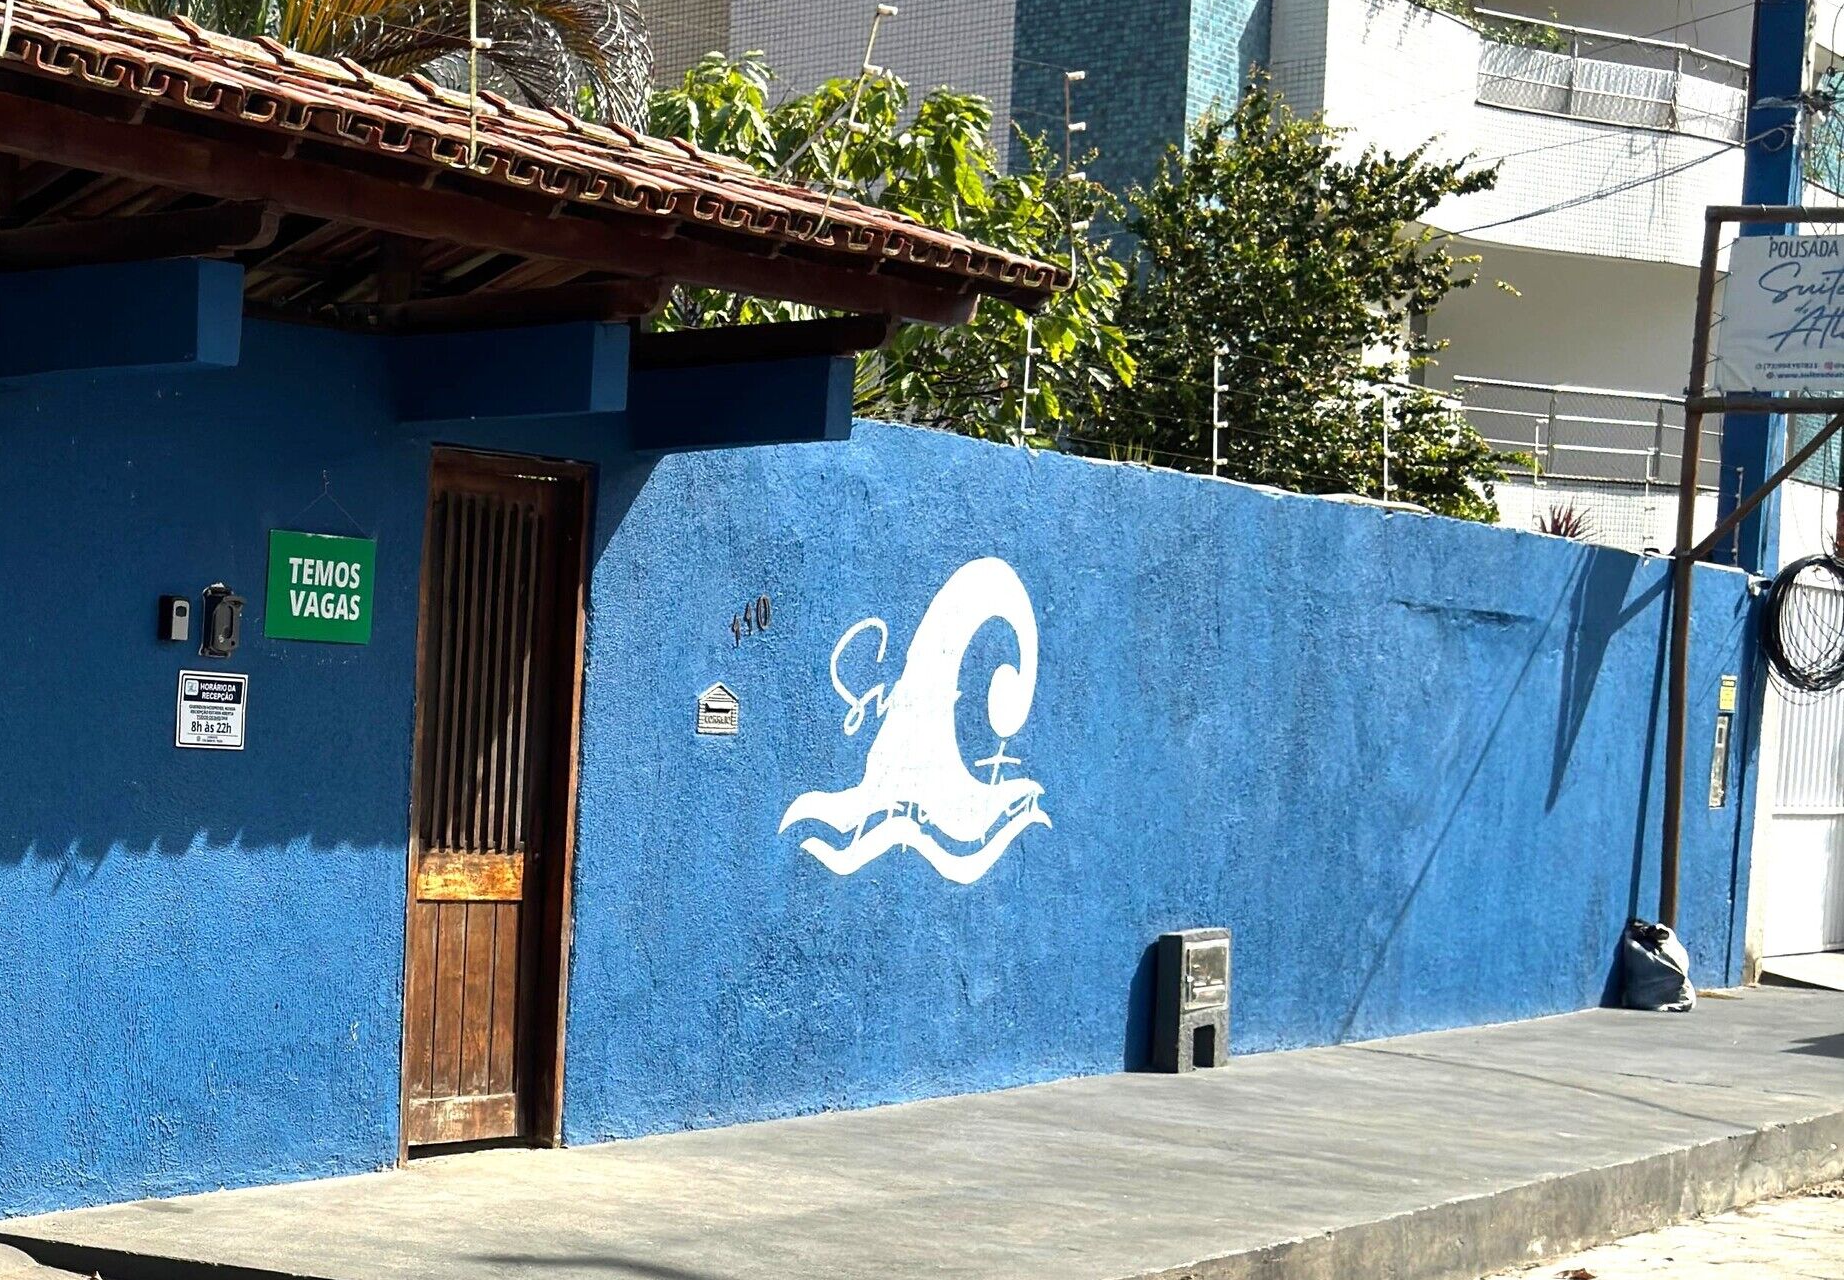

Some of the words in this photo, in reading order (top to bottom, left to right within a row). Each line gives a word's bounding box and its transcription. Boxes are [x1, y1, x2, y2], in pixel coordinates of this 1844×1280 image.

[1768, 240, 1839, 258] POUSADA
[288, 557, 361, 589] TEMOS
[289, 589, 360, 621] VAGAS
[200, 682, 227, 691] HORÁRIO
[201, 692, 233, 701] RECEPÇÃO
[191, 721, 202, 732] 8h
[204, 721, 214, 733] às
[216, 722, 231, 734] 22h
